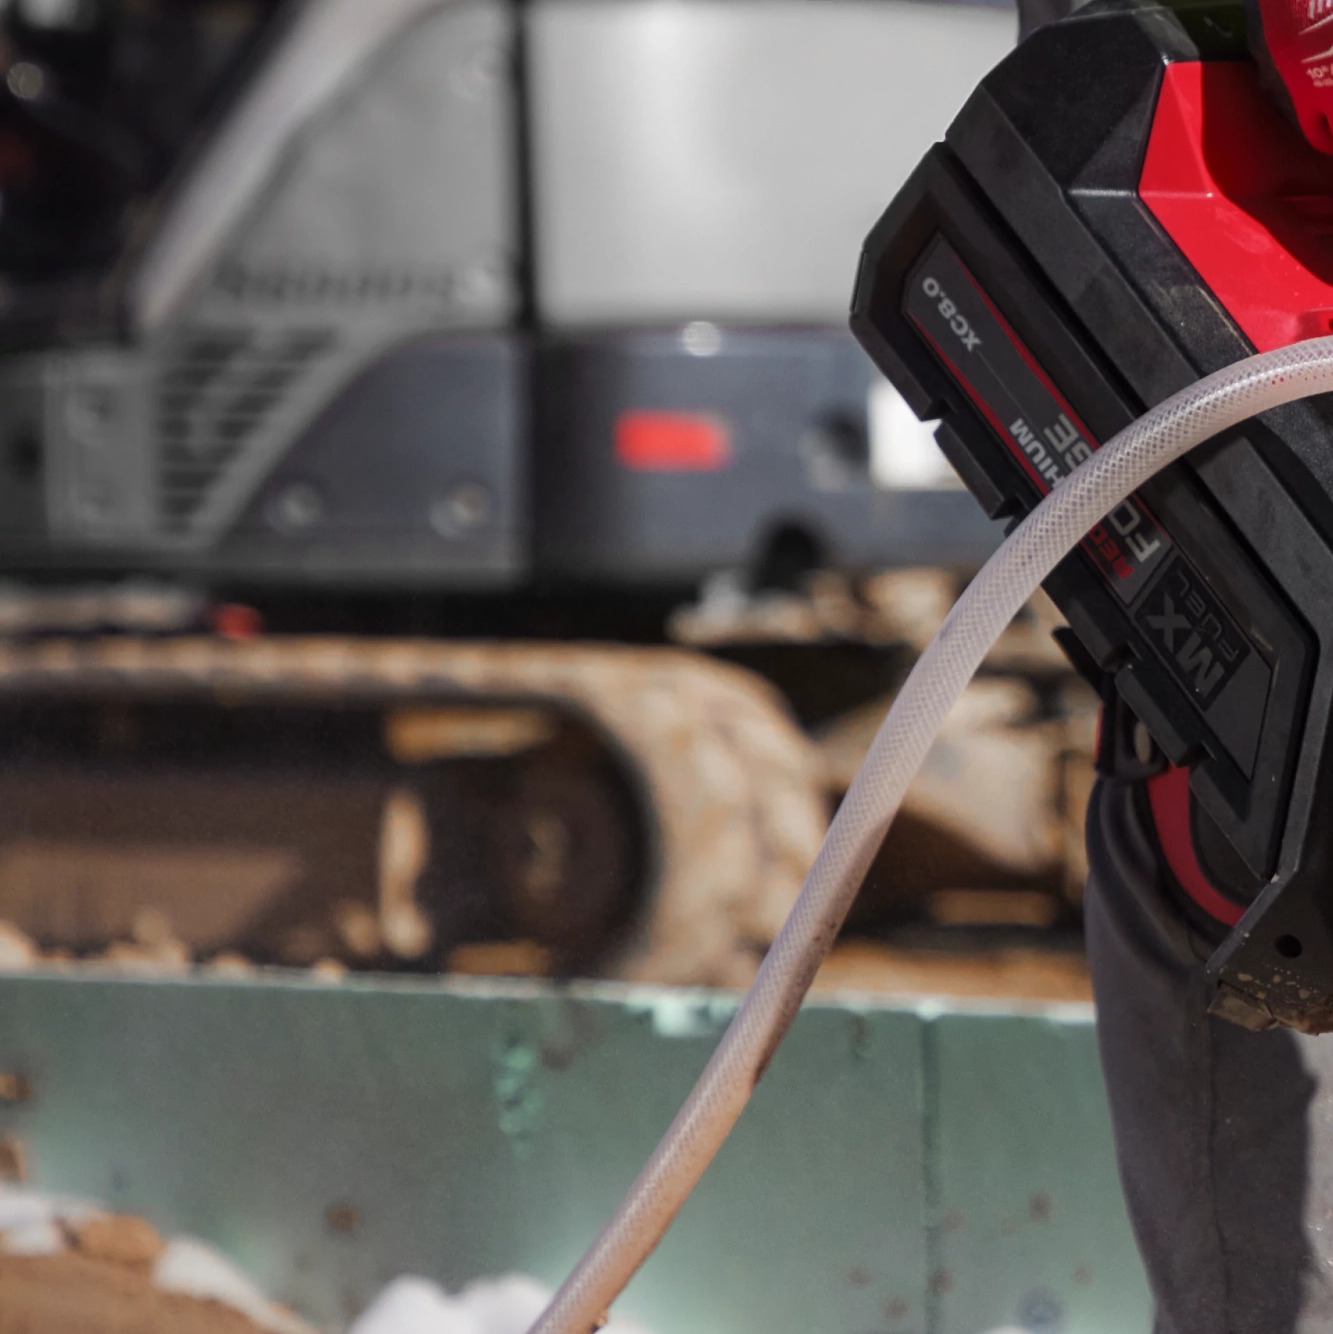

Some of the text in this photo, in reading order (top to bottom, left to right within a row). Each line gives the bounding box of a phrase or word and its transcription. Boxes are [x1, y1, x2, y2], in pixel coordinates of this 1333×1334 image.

[922, 276, 983, 352] XC8.0
[1148, 590, 1226, 698] MX
[1177, 569, 1239, 662] FUEL
